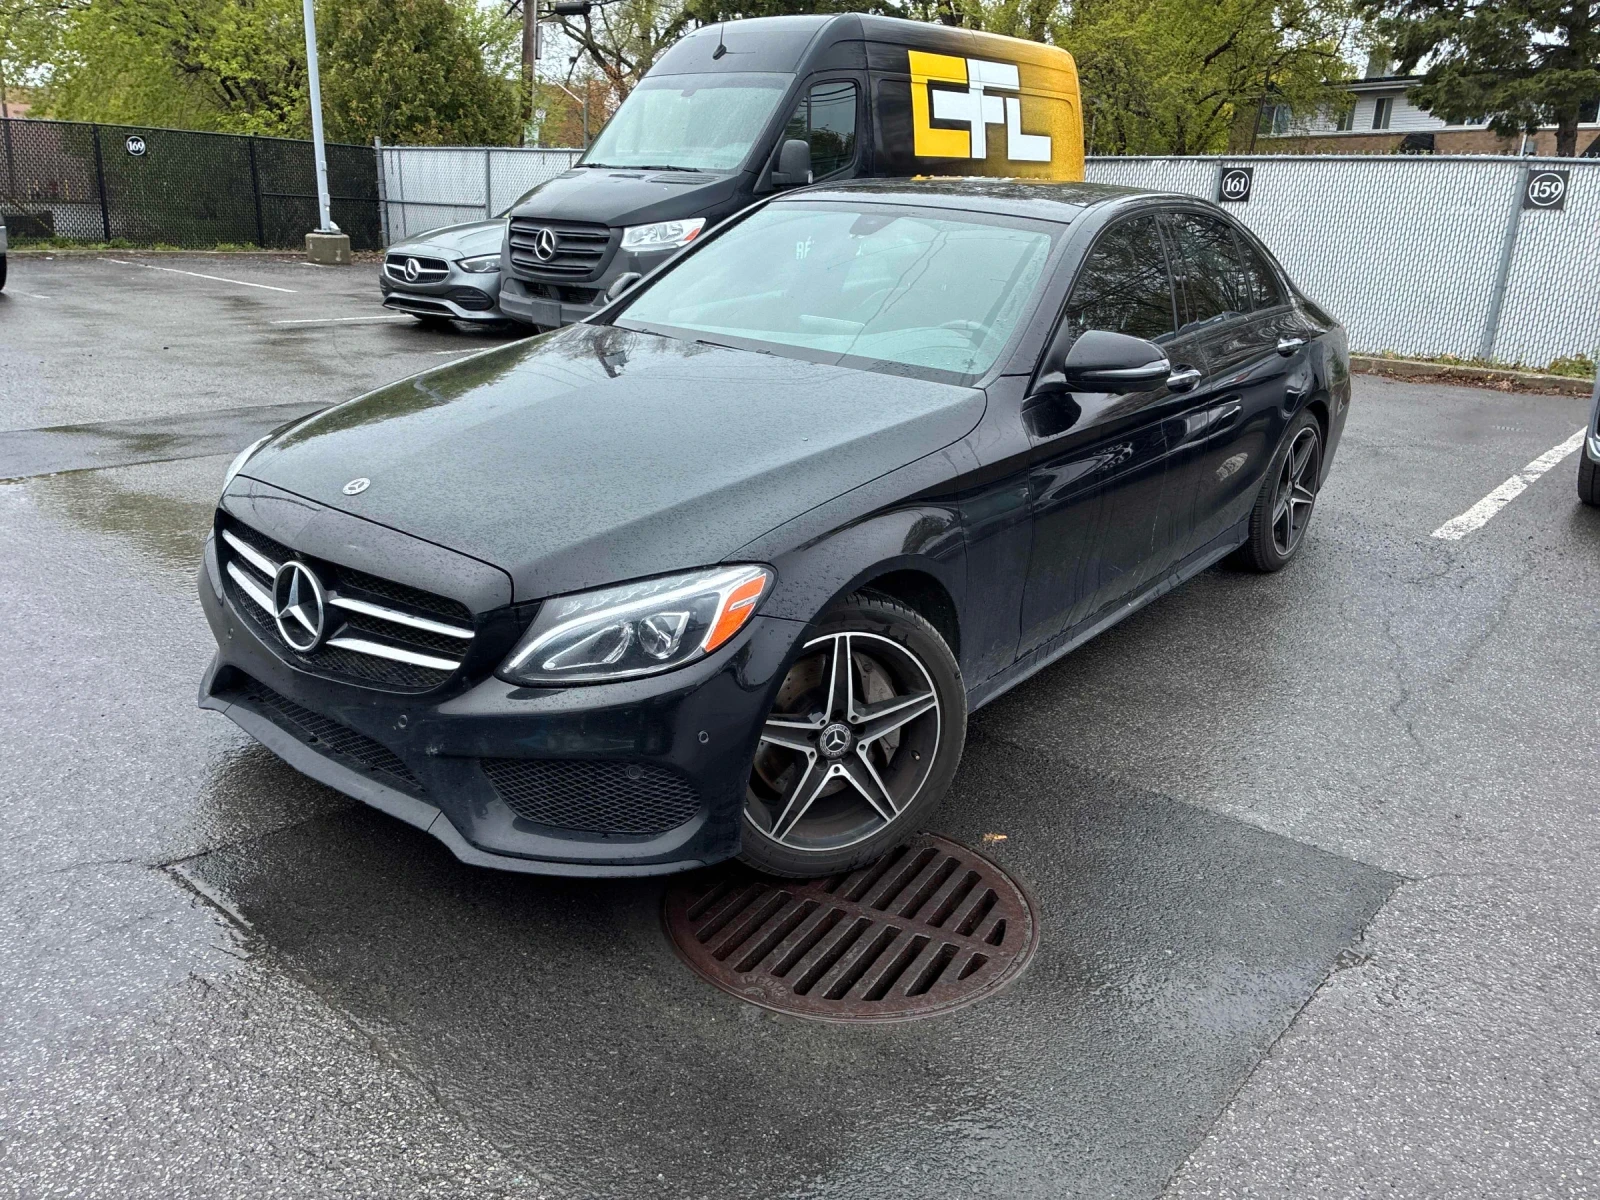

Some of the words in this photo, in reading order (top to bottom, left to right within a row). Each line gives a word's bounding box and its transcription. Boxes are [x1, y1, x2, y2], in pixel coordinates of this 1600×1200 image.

[128, 141, 145, 151] 169
[1226, 177, 1246, 192] 161
[1532, 181, 1562, 198] 159
